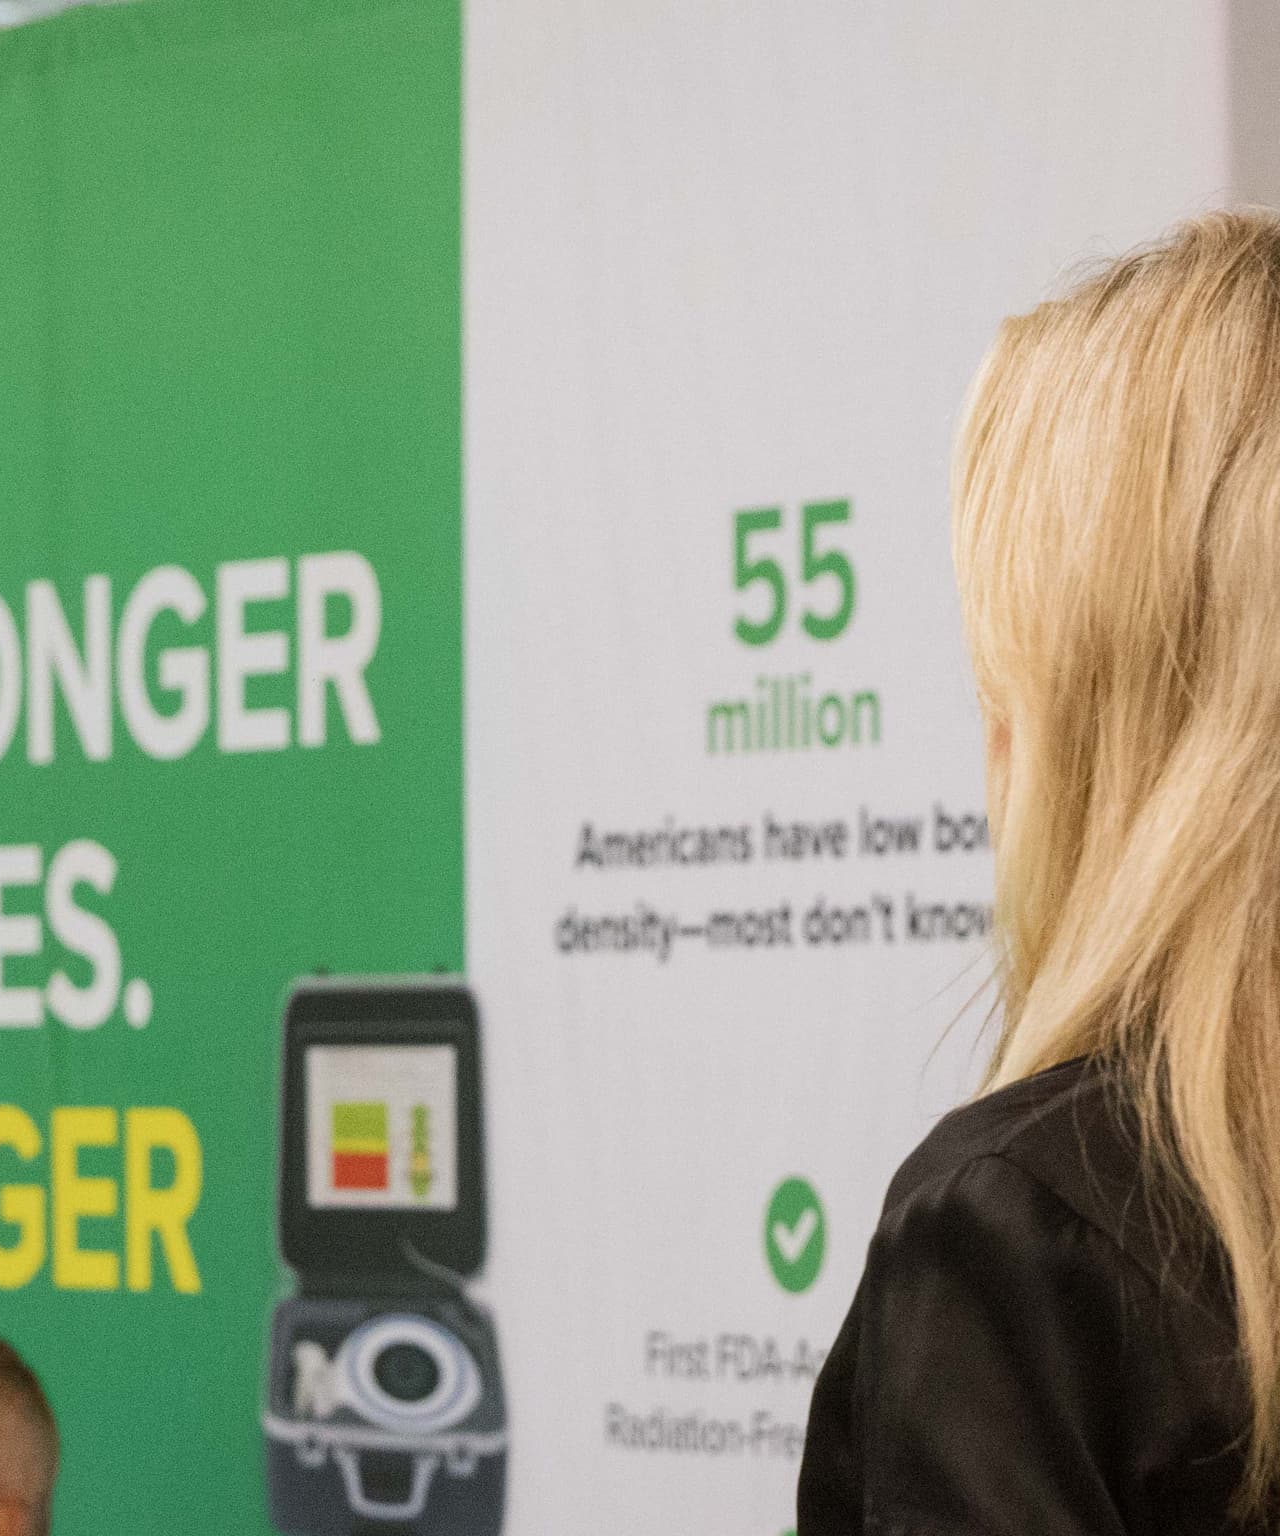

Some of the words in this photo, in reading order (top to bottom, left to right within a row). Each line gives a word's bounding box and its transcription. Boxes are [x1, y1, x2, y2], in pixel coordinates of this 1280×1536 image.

[732, 497, 859, 646] 55
[706, 672, 882, 754] million
[574, 815, 753, 871] Americans
[763, 811, 849, 861] have
[860, 807, 923, 857] low
